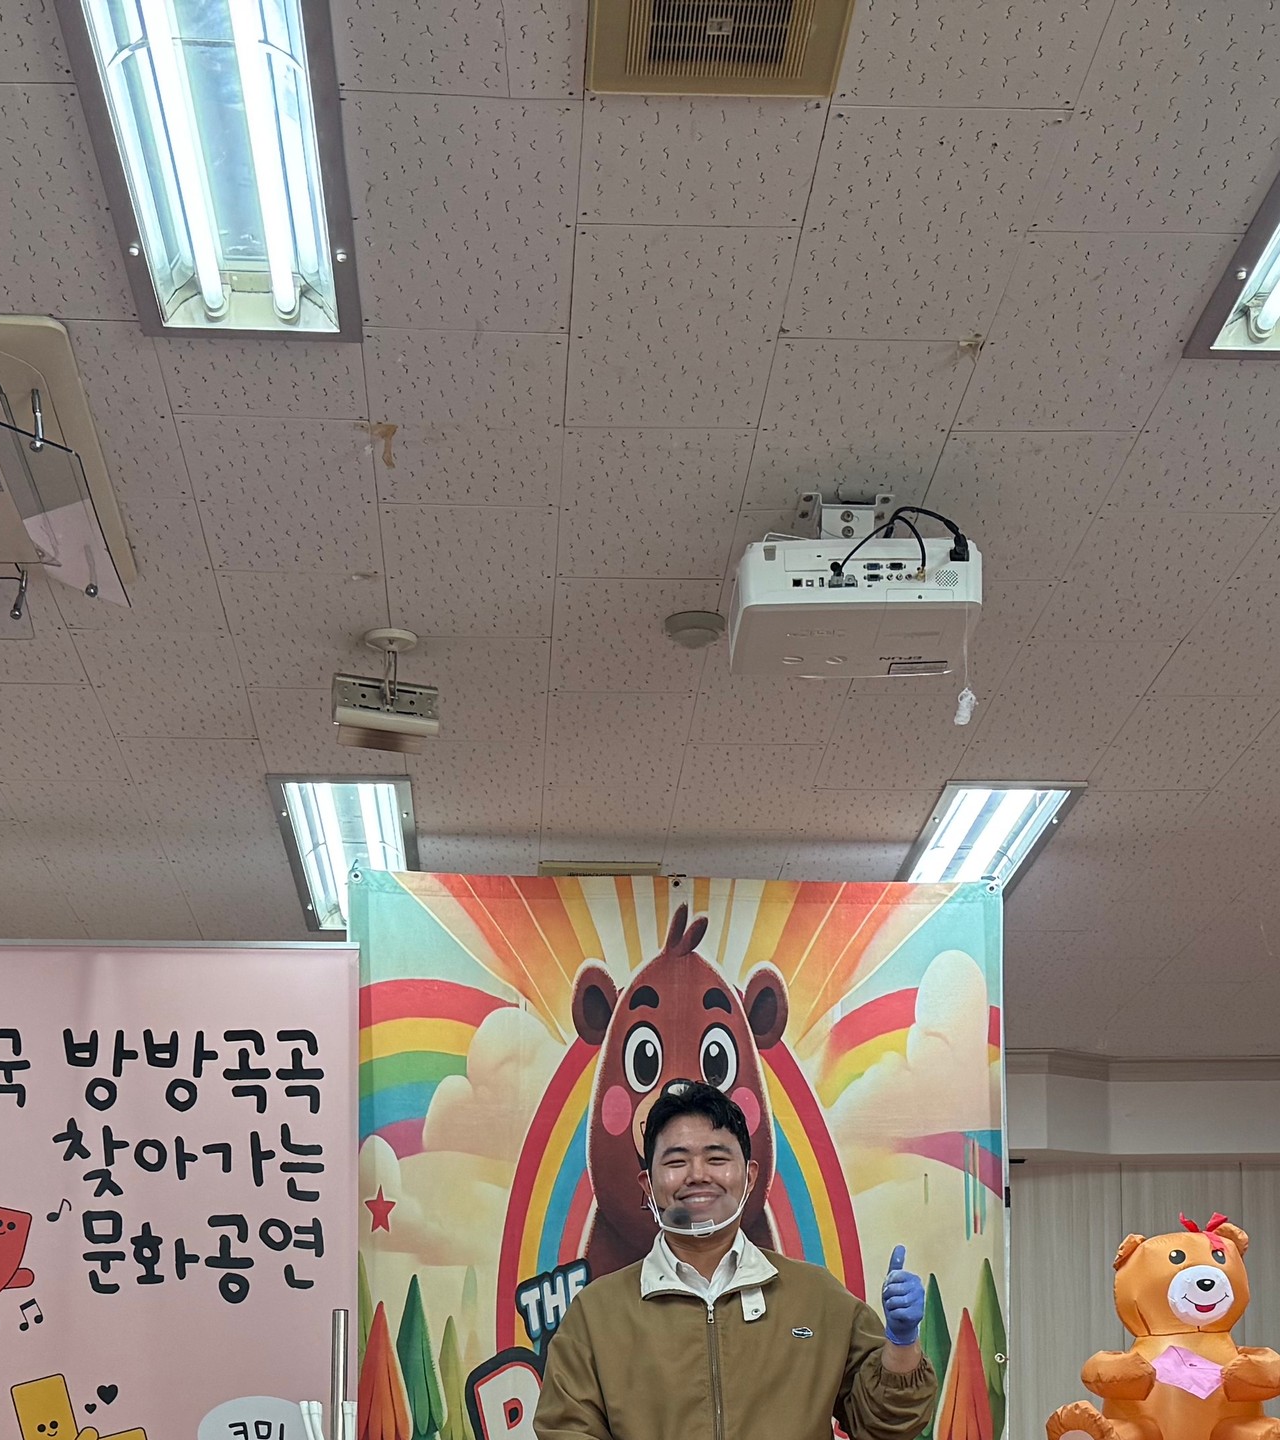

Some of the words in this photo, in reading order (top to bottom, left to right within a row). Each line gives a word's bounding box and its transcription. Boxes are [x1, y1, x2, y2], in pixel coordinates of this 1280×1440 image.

[62, 1028, 325, 1114] 방방곡곡
[52, 1117, 325, 1202] 찾아가는
[81, 1211, 325, 1304] 문화공연
